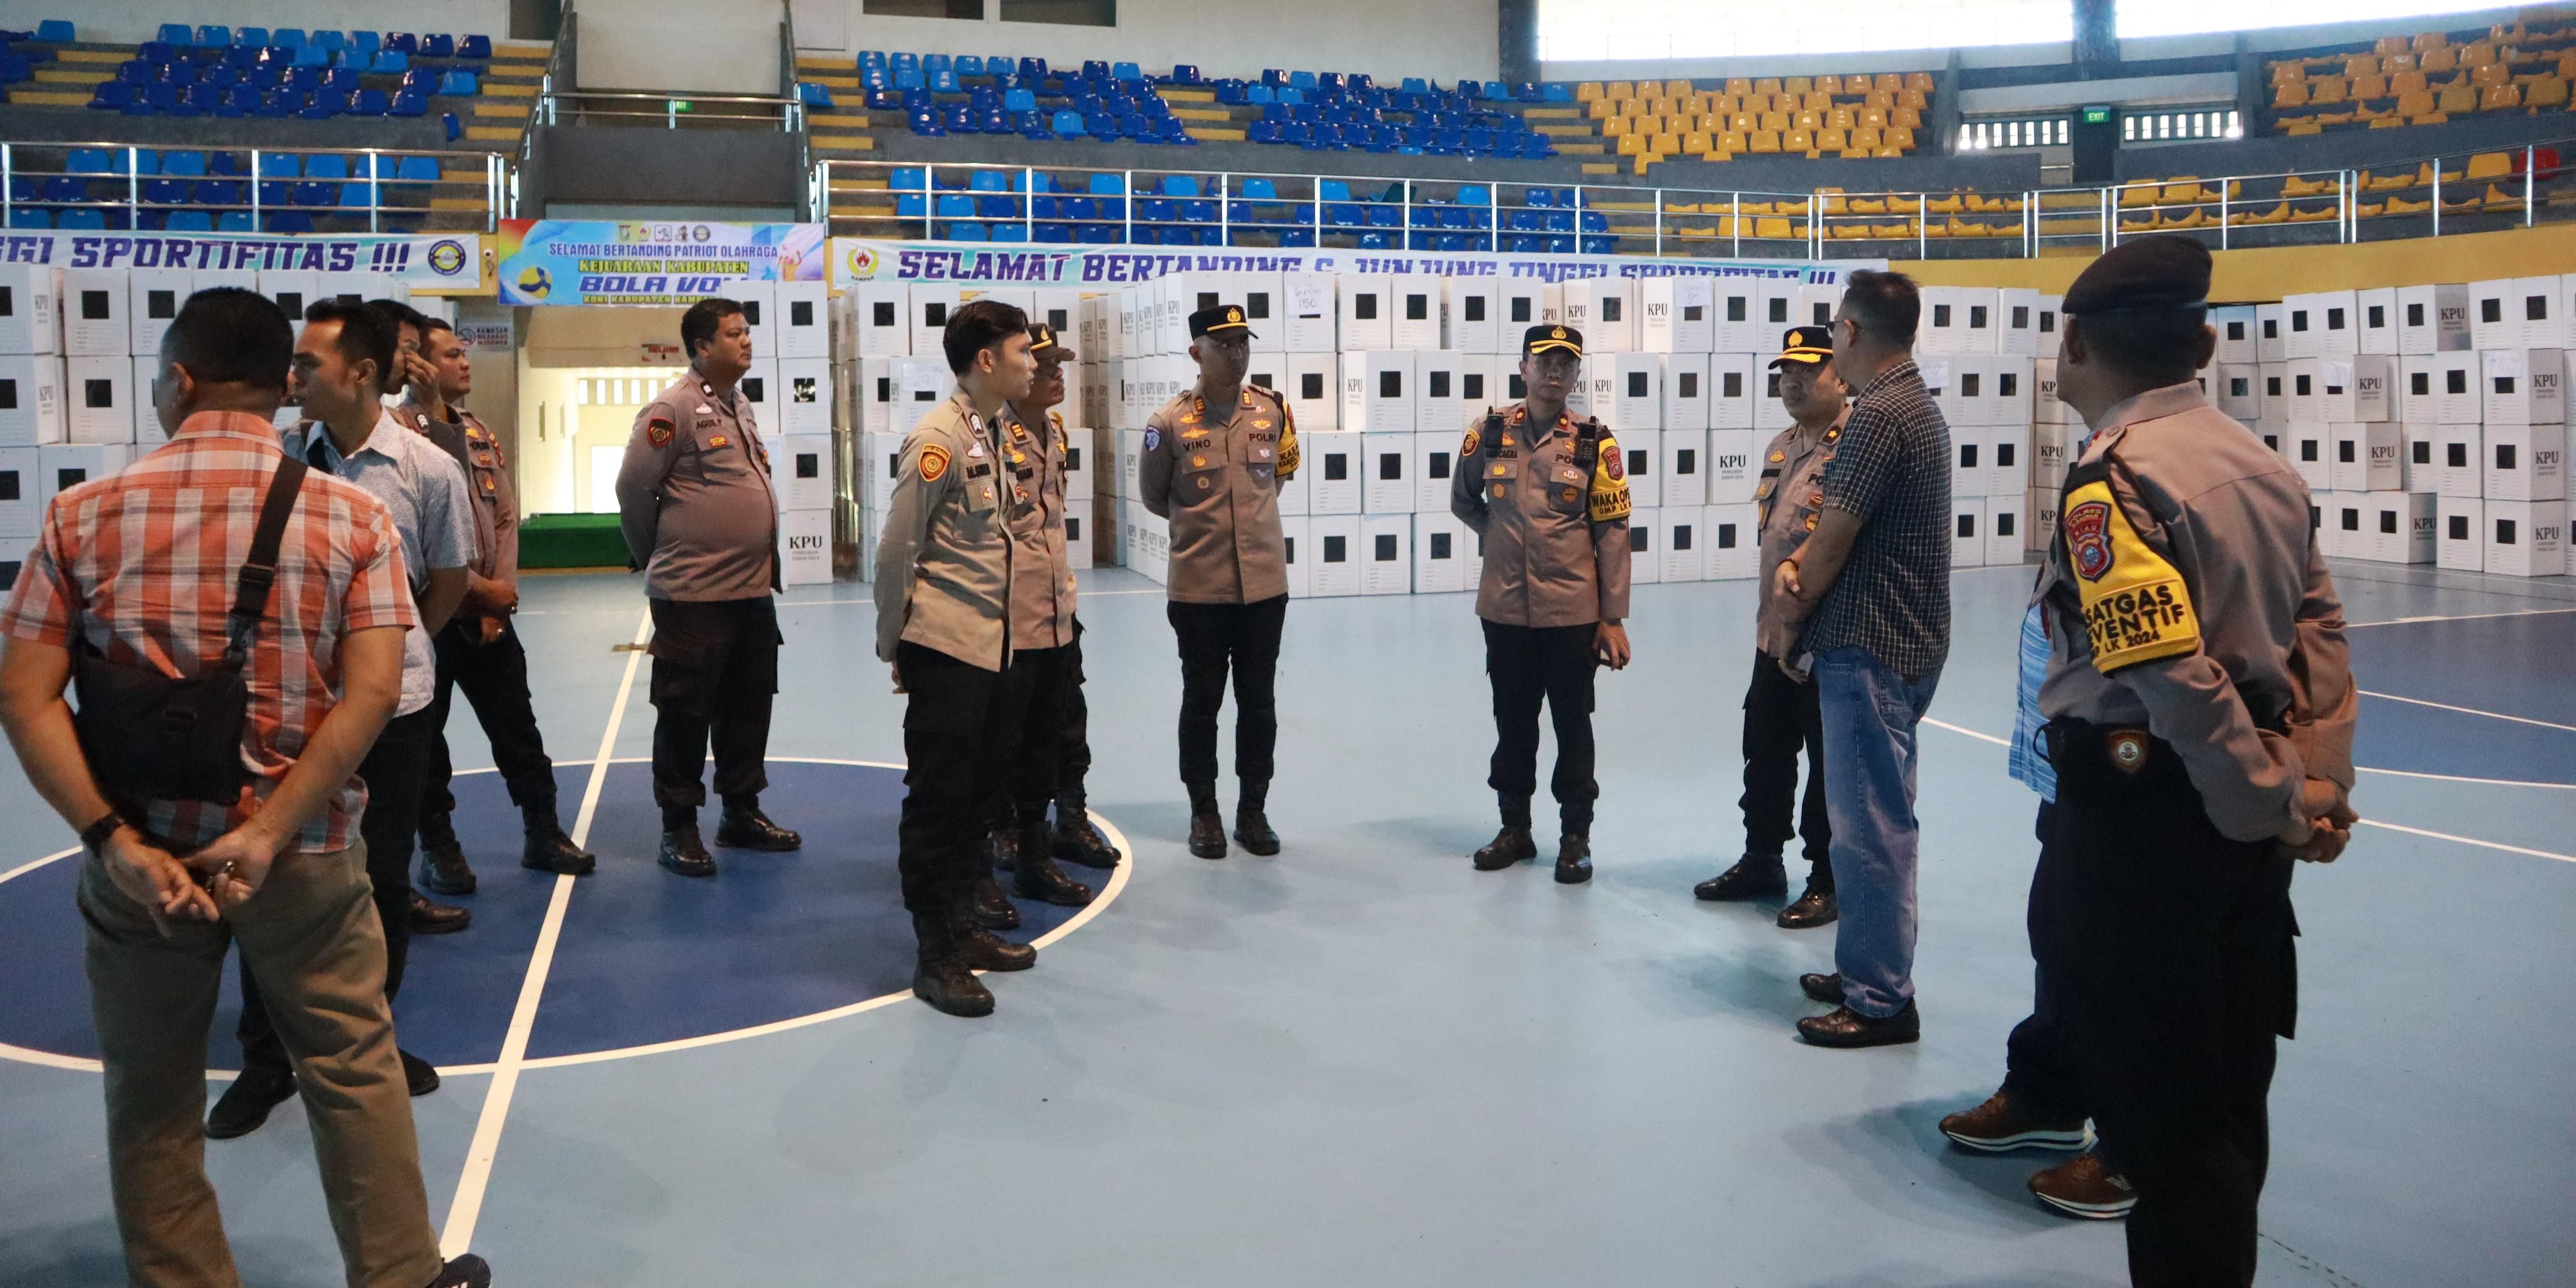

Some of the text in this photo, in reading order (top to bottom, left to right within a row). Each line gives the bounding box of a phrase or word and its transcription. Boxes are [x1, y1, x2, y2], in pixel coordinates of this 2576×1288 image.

[2089, 112, 2105, 121] EXIT
[71, 237, 357, 271] SPORTIFITAS
[372, 242, 411, 271] !!!
[549, 243, 778, 258] SELAMAT BERTANDING PATRIOT OLAHRAGA
[578, 259, 749, 273] KEJUARAAN KABUPATEN
[898, 251, 1070, 281] SELAMAT
[1082, 253, 1302, 282] BERTANDING
[580, 276, 667, 292] BOLA
[583, 295, 609, 304] KONI
[611, 295, 672, 304] KABUPATEN
[1168, 300, 1180, 314] KPU
[1568, 305, 1586, 317] KPU
[1648, 303, 1668, 316] KPU
[2441, 307, 2465, 320] KPU
[1347, 379, 1363, 393] KPU
[1595, 380, 1612, 392] KPU
[2359, 378, 2382, 390] KPU
[2534, 374, 2558, 388] KPU
[1249, 432, 1276, 442] POLRI
[1183, 438, 1211, 451] VINO
[2041, 445, 2063, 457] KPU
[2371, 446, 2395, 458] KPU
[2536, 451, 2559, 464] KPU
[1720, 455, 1746, 468] KPU
[1591, 492, 1619, 508] WAKA
[1599, 503, 1628, 515] OMP LK
[2414, 517, 2437, 530] KPU
[2535, 526, 2559, 540] KPU
[789, 535, 822, 549] KPU
[2106, 639, 2120, 653] LK
[2126, 629, 2161, 648] 2024
